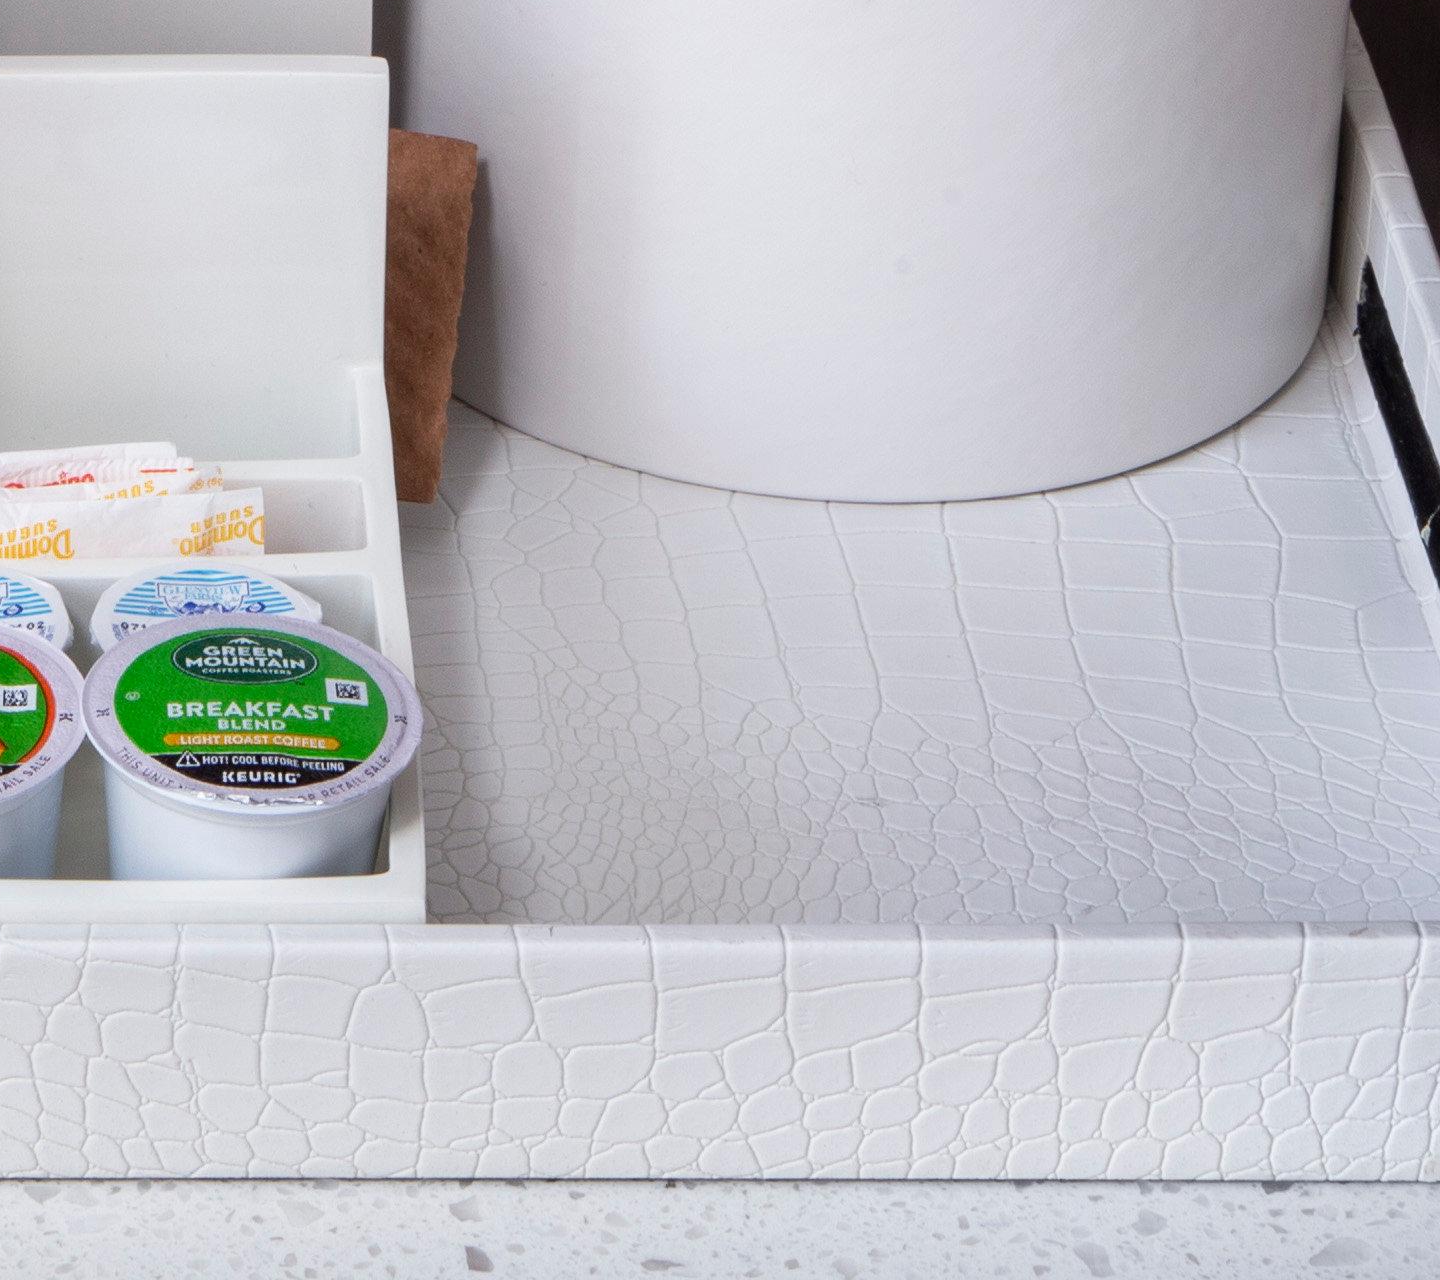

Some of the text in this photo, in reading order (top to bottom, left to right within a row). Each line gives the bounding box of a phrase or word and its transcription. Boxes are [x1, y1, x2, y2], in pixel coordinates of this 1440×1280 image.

[190, 505, 254, 533] SUGAR
[203, 645, 283, 658] GREEN
[185, 656, 306, 670] MOUNTAIN
[201, 667, 292, 675] COFFEE ROASTERS
[166, 701, 335, 722] BREAKFAST
[217, 718, 286, 731] BLEND
[180, 735, 327, 749] LIGHT ROAST COFFEE
[23, 754, 52, 778] SALE
[118, 746, 176, 787] THIS UNIT
[202, 755, 346, 772] HOT! COOL BEFORE PEELING
[322, 753, 393, 799] RETAIL SALE
